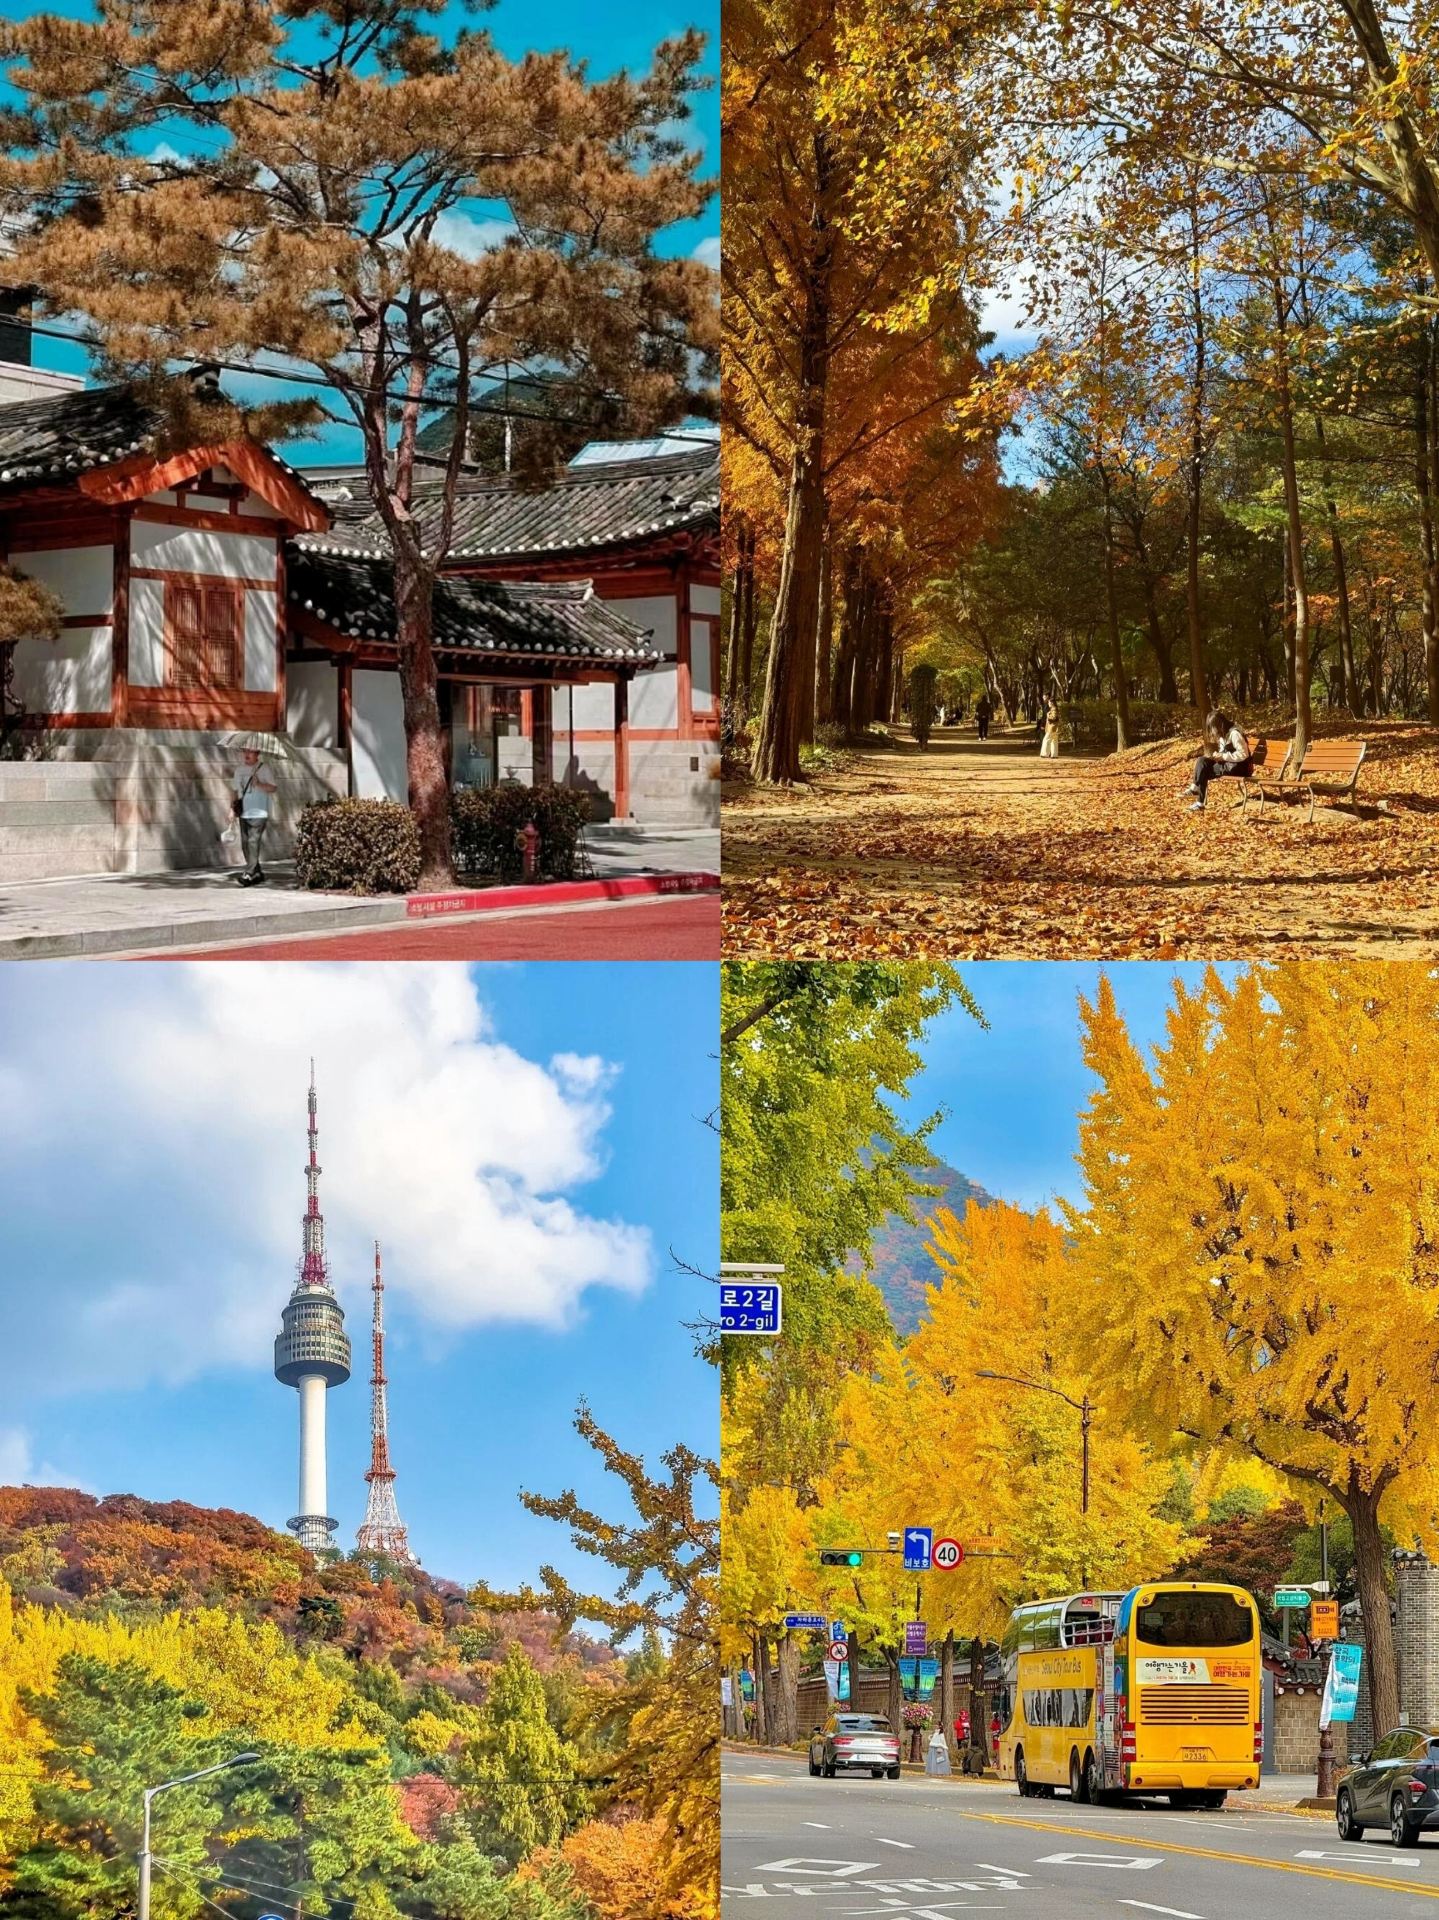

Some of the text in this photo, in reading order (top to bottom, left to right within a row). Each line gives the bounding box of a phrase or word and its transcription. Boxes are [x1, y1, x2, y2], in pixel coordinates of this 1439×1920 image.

[739, 1313, 774, 1330] 2-gil
[938, 1547, 957, 1562] 40
[904, 1557, 930, 1569] 비보호
[1042, 1658, 1053, 1675] Seoul
[1054, 1657, 1062, 1678] City
[1062, 1657, 1072, 1673] Tour
[1073, 1656, 1082, 1673] Bus
